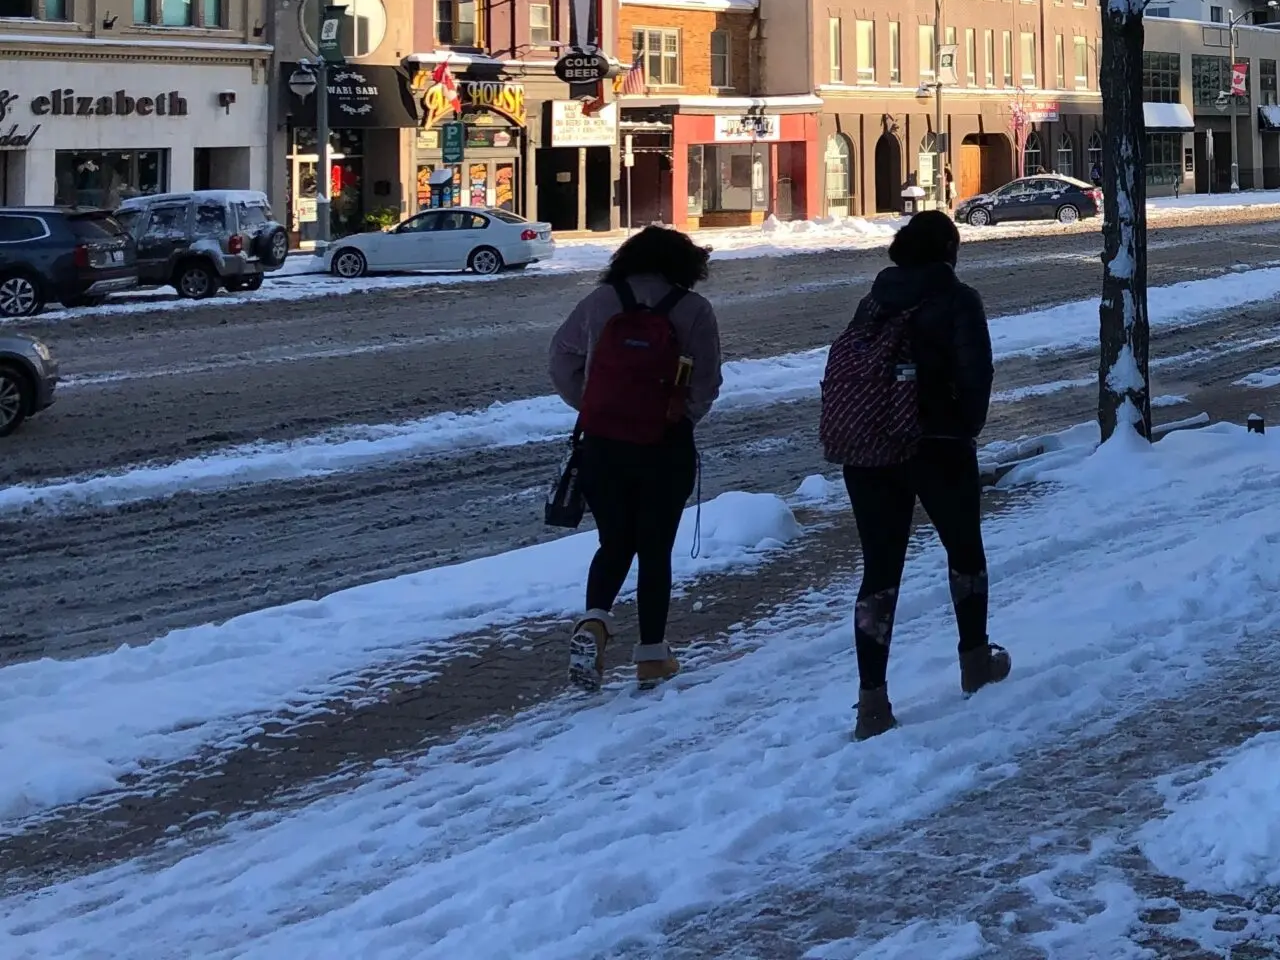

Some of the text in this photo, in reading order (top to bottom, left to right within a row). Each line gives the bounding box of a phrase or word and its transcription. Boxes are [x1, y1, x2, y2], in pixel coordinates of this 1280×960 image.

[565, 58, 599, 67] COLD
[565, 68, 599, 78] BEER
[327, 86, 379, 95] WABI SABI
[31, 88, 188, 116] elizabeth
[467, 82, 526, 124] HOUSE
[446, 126, 458, 140] P
